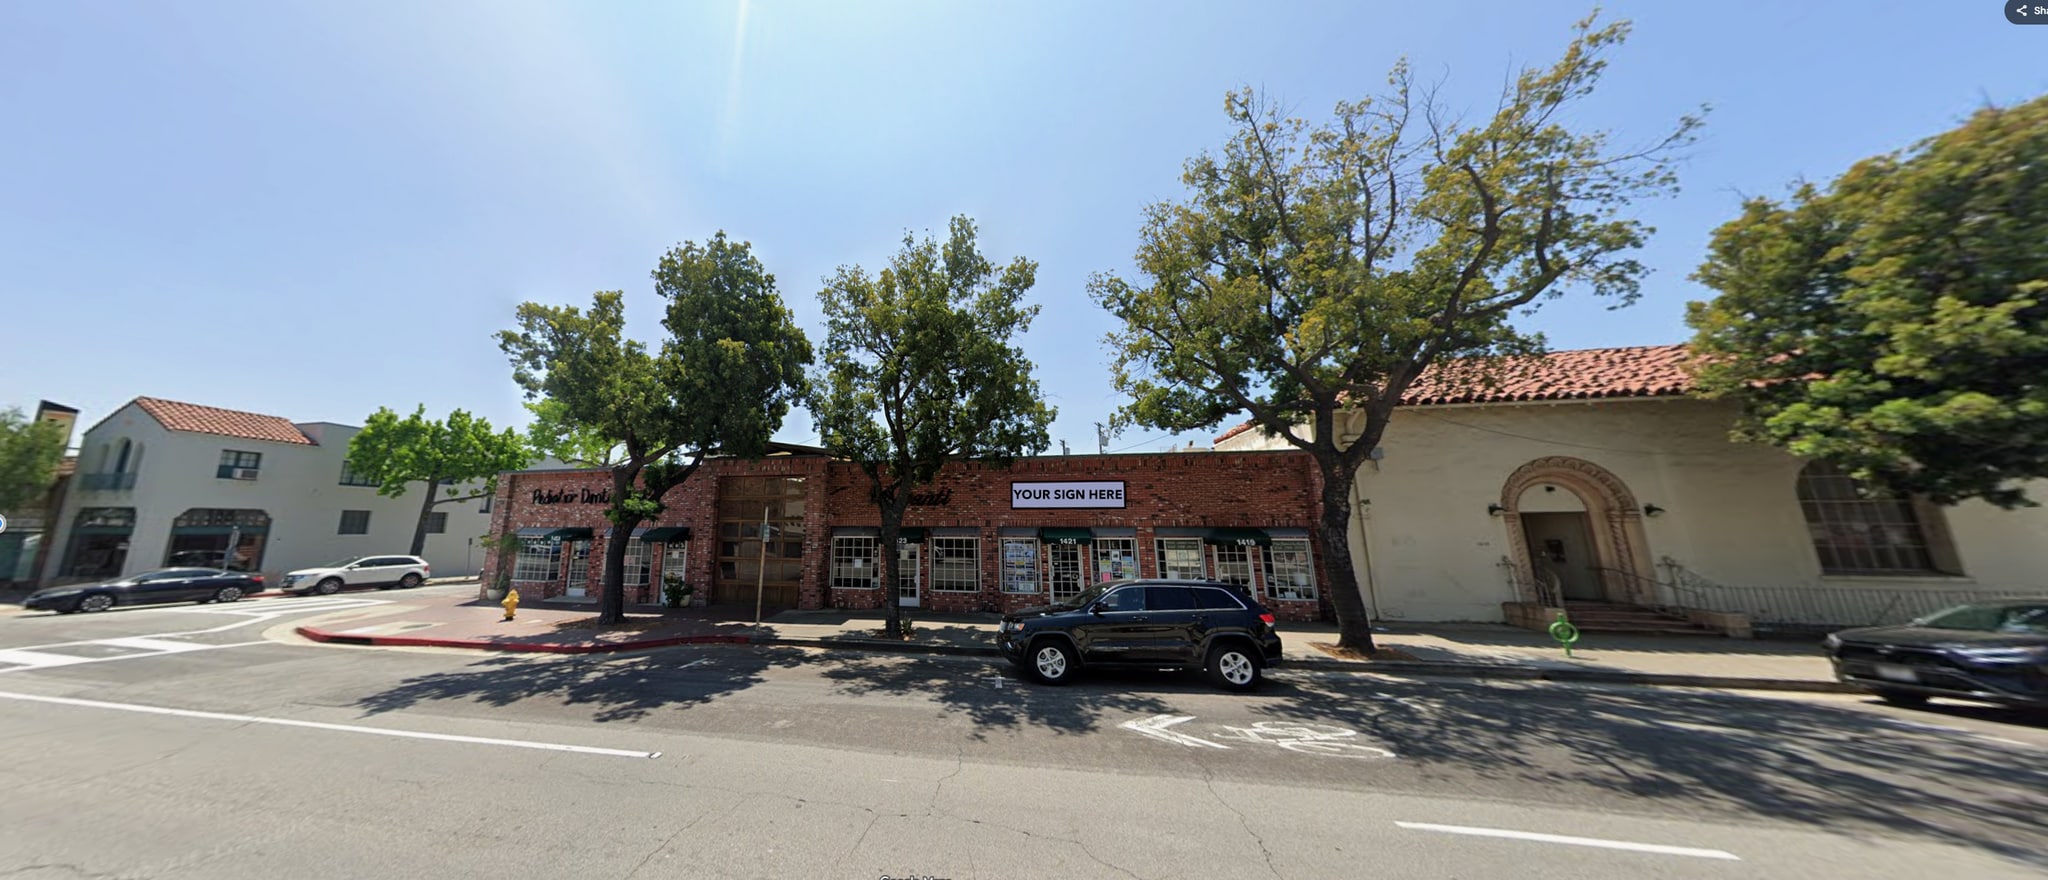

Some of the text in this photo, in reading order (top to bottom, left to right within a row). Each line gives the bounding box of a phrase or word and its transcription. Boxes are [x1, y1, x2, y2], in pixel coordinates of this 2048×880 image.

[1013, 489, 1123, 500] YOUR SIGN HERE
[1060, 537, 1077, 545] 1421
